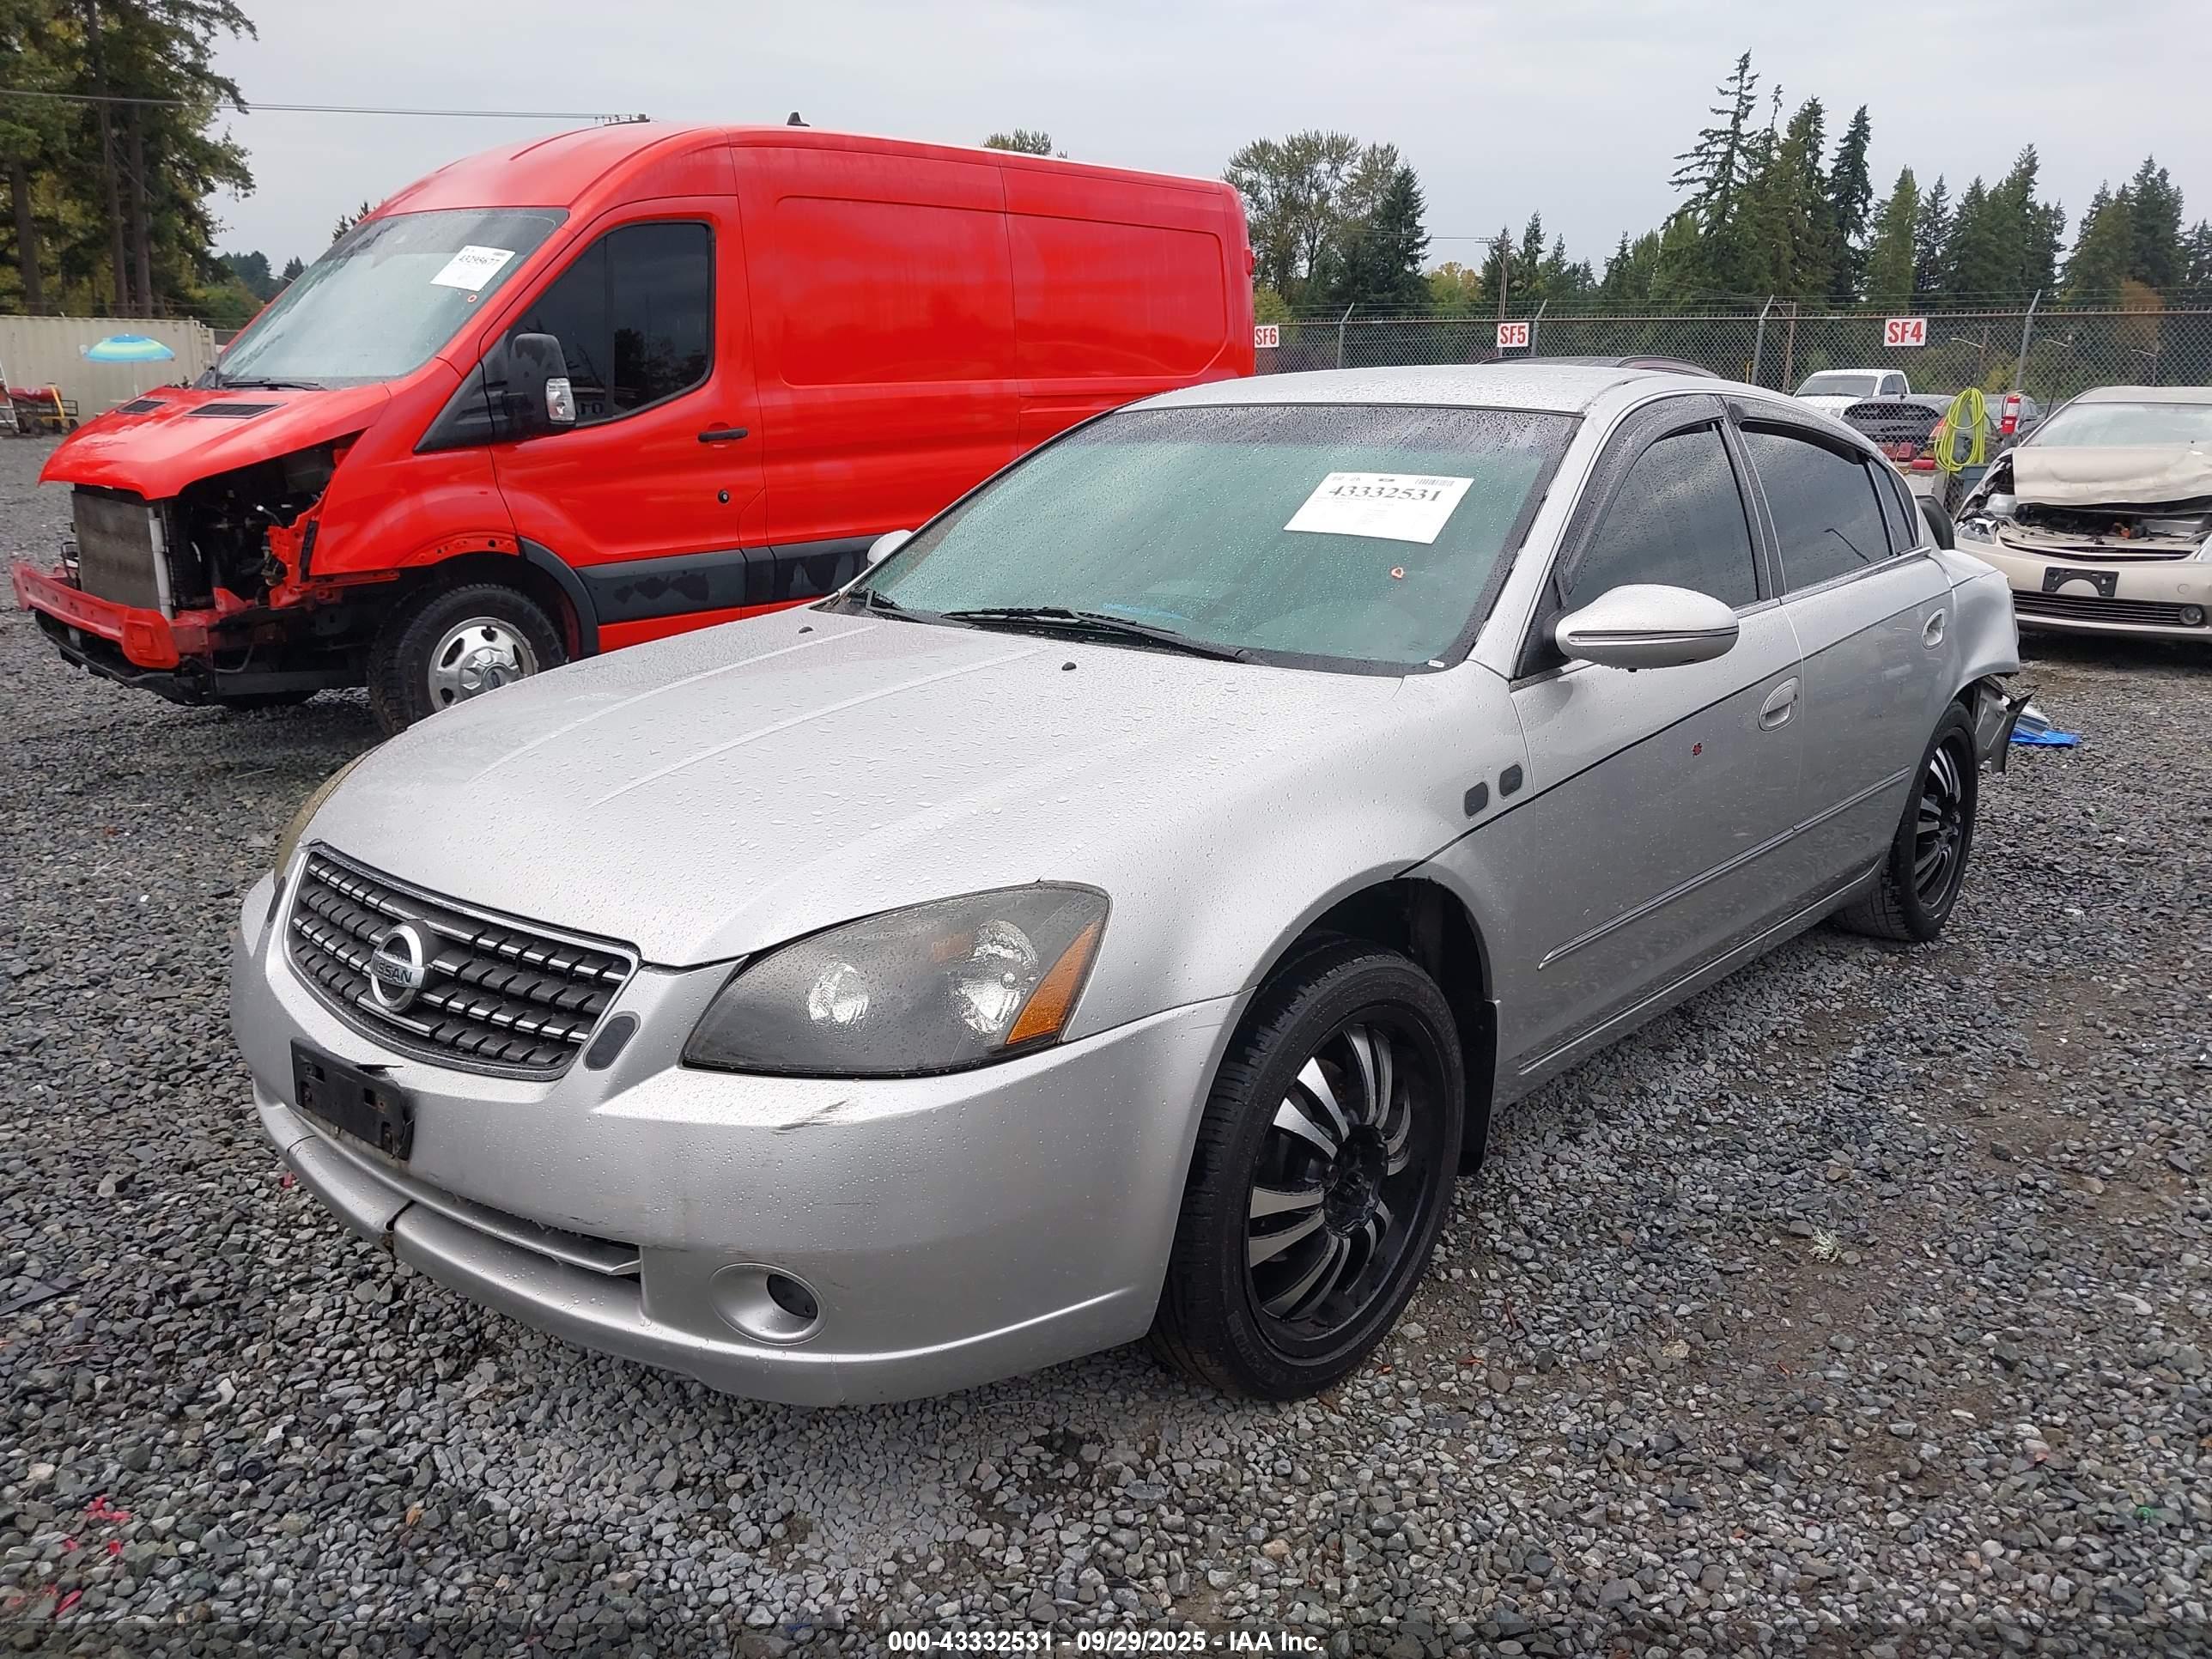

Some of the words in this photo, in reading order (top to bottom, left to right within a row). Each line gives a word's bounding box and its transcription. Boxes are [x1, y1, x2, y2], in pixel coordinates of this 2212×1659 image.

[1255, 327, 1277, 345] SF6
[1500, 325, 1526, 344] SF5
[1887, 321, 1923, 343] SF4
[1328, 485, 1442, 501] 43332531
[372, 956, 413, 983] NISSAN
